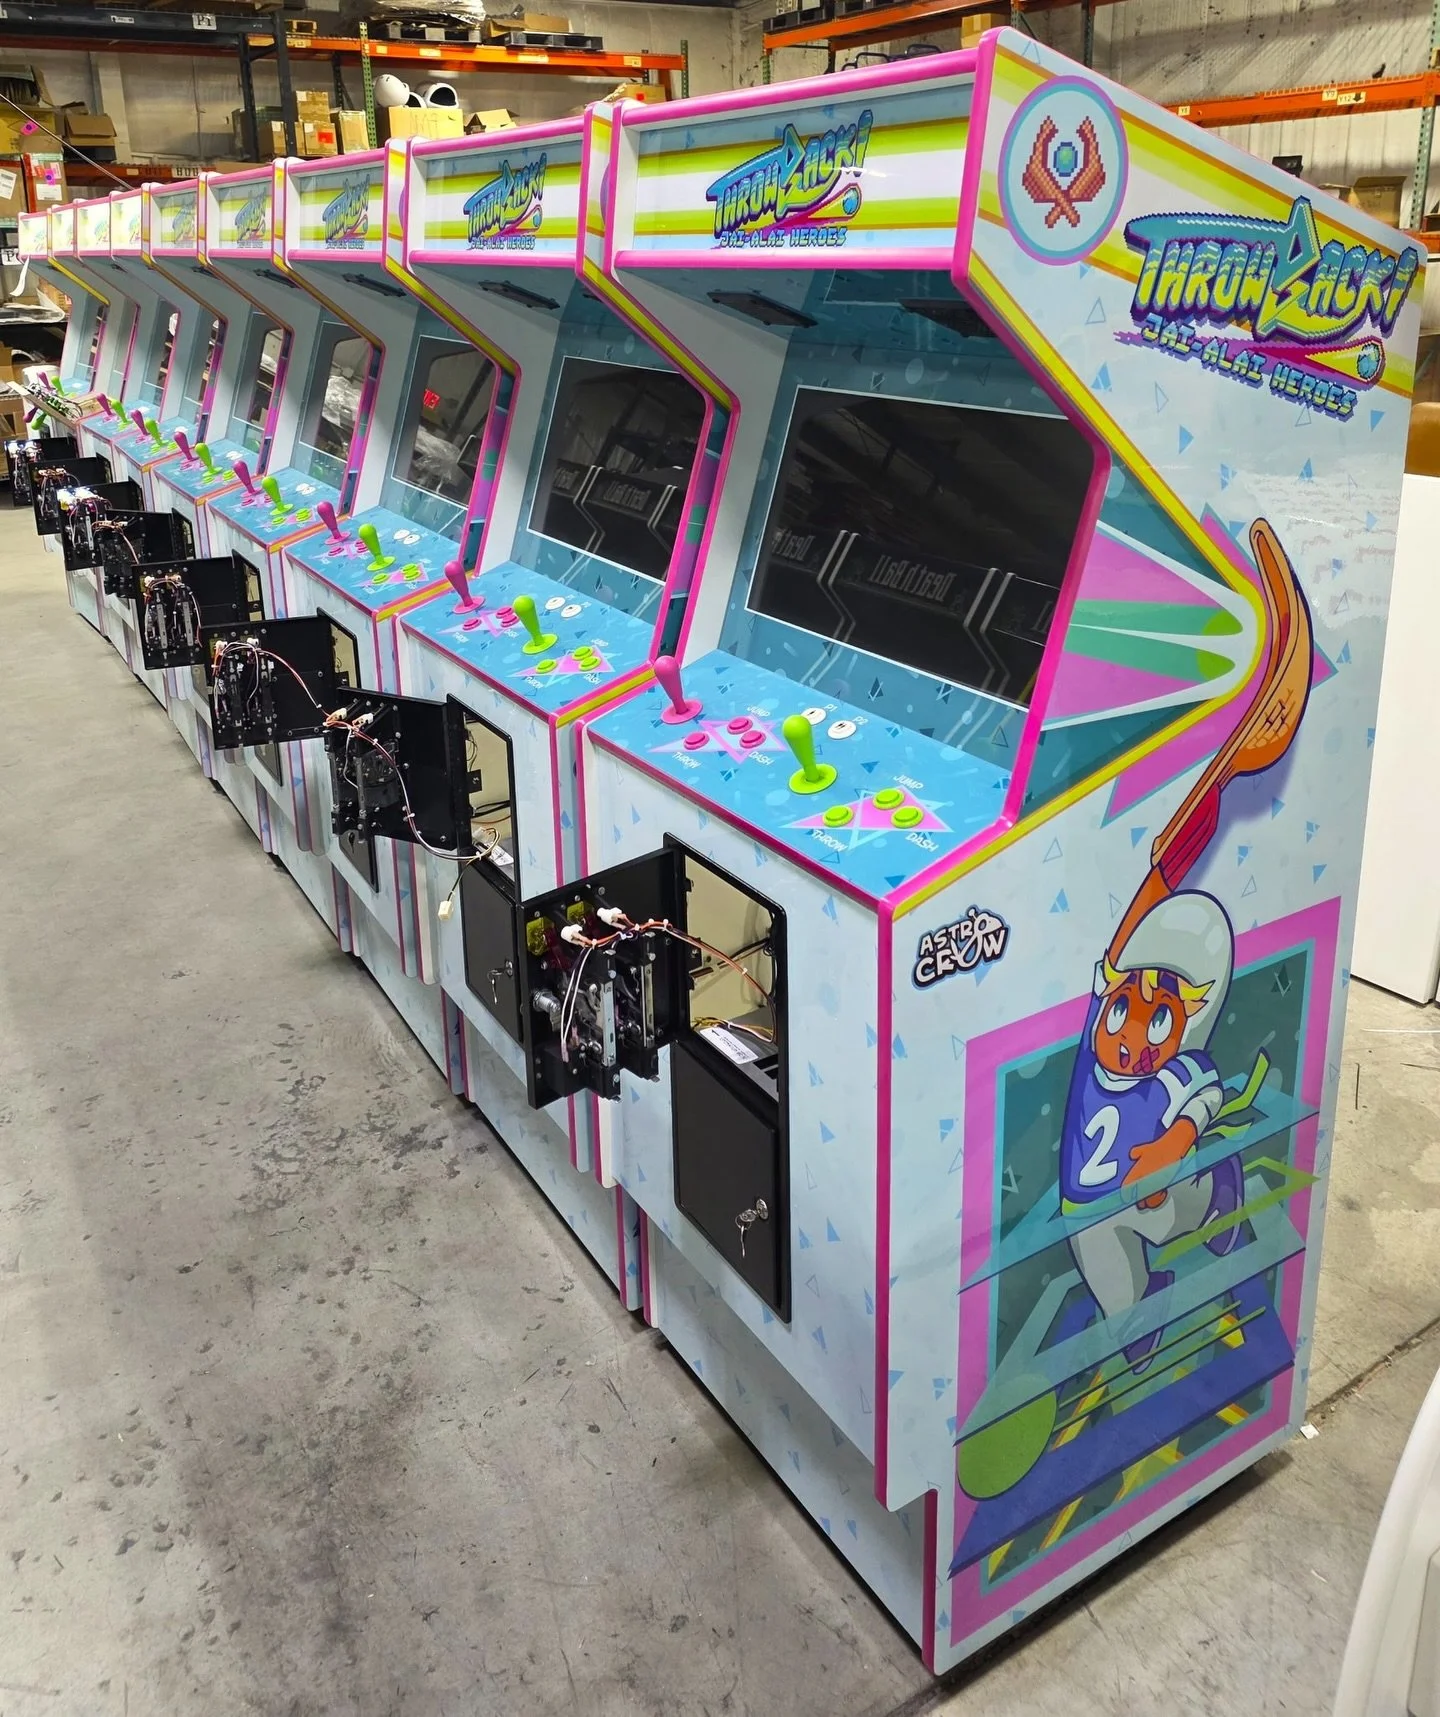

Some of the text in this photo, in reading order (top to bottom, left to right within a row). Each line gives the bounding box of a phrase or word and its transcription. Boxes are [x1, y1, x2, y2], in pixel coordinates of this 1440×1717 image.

[706, 109, 873, 239] THROWBACK!
[720, 226, 848, 248] JAI-ALAI HEROES
[1123, 195, 1419, 344] THROWBACK!
[1141, 312, 1358, 417] JAI-ALAI HEROES
[746, 705, 771, 718] JUMP
[824, 703, 838, 712] P1
[852, 715, 869, 727] P2
[672, 751, 702, 769] THROW
[749, 751, 775, 767] DASH
[893, 774, 924, 790] JUMP
[811, 829, 848, 853] THROW
[905, 832, 939, 853] DASH
[919, 911, 1002, 956] ASTRO
[915, 929, 1006, 983] CROW
[1079, 1105, 1120, 1187] 2
